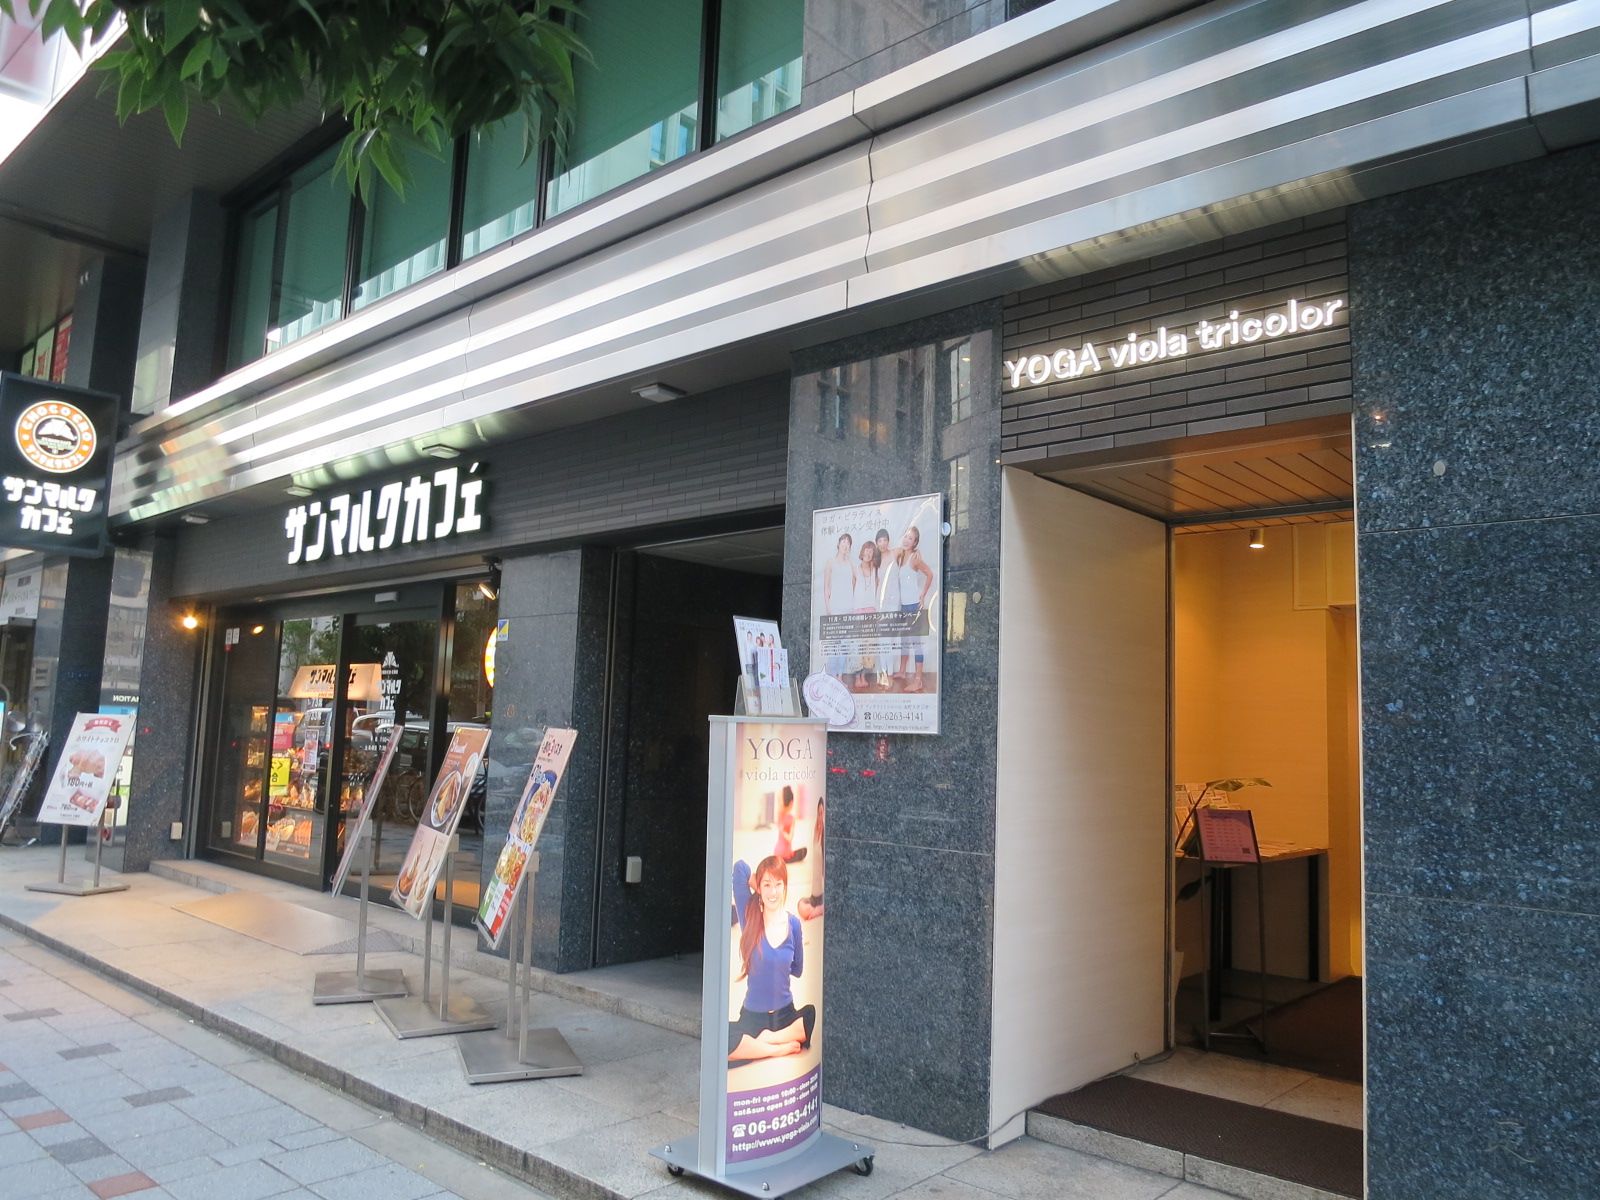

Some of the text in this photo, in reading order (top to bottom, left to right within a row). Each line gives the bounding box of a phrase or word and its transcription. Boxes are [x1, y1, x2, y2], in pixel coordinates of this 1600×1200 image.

[1004, 299, 1344, 389] YOGA viola tricolor
[21, 404, 71, 430] CHOCO
[72, 414, 93, 441] CRO
[2, 476, 97, 512] サンマルク
[20, 505, 73, 535] カフェ
[285, 462, 483, 565] サンマルクカフェ
[872, 711, 924, 721] 06-6263-4141
[747, 738, 814, 760] YOGA
[746, 766, 816, 781] viola tricolor
[733, 1096, 761, 1107] mon-fri
[763, 1093, 780, 1103] open
[733, 1107, 765, 1117] sat&sun
[767, 1102, 783, 1112] open
[748, 1096, 818, 1136] 06-6263-4141
